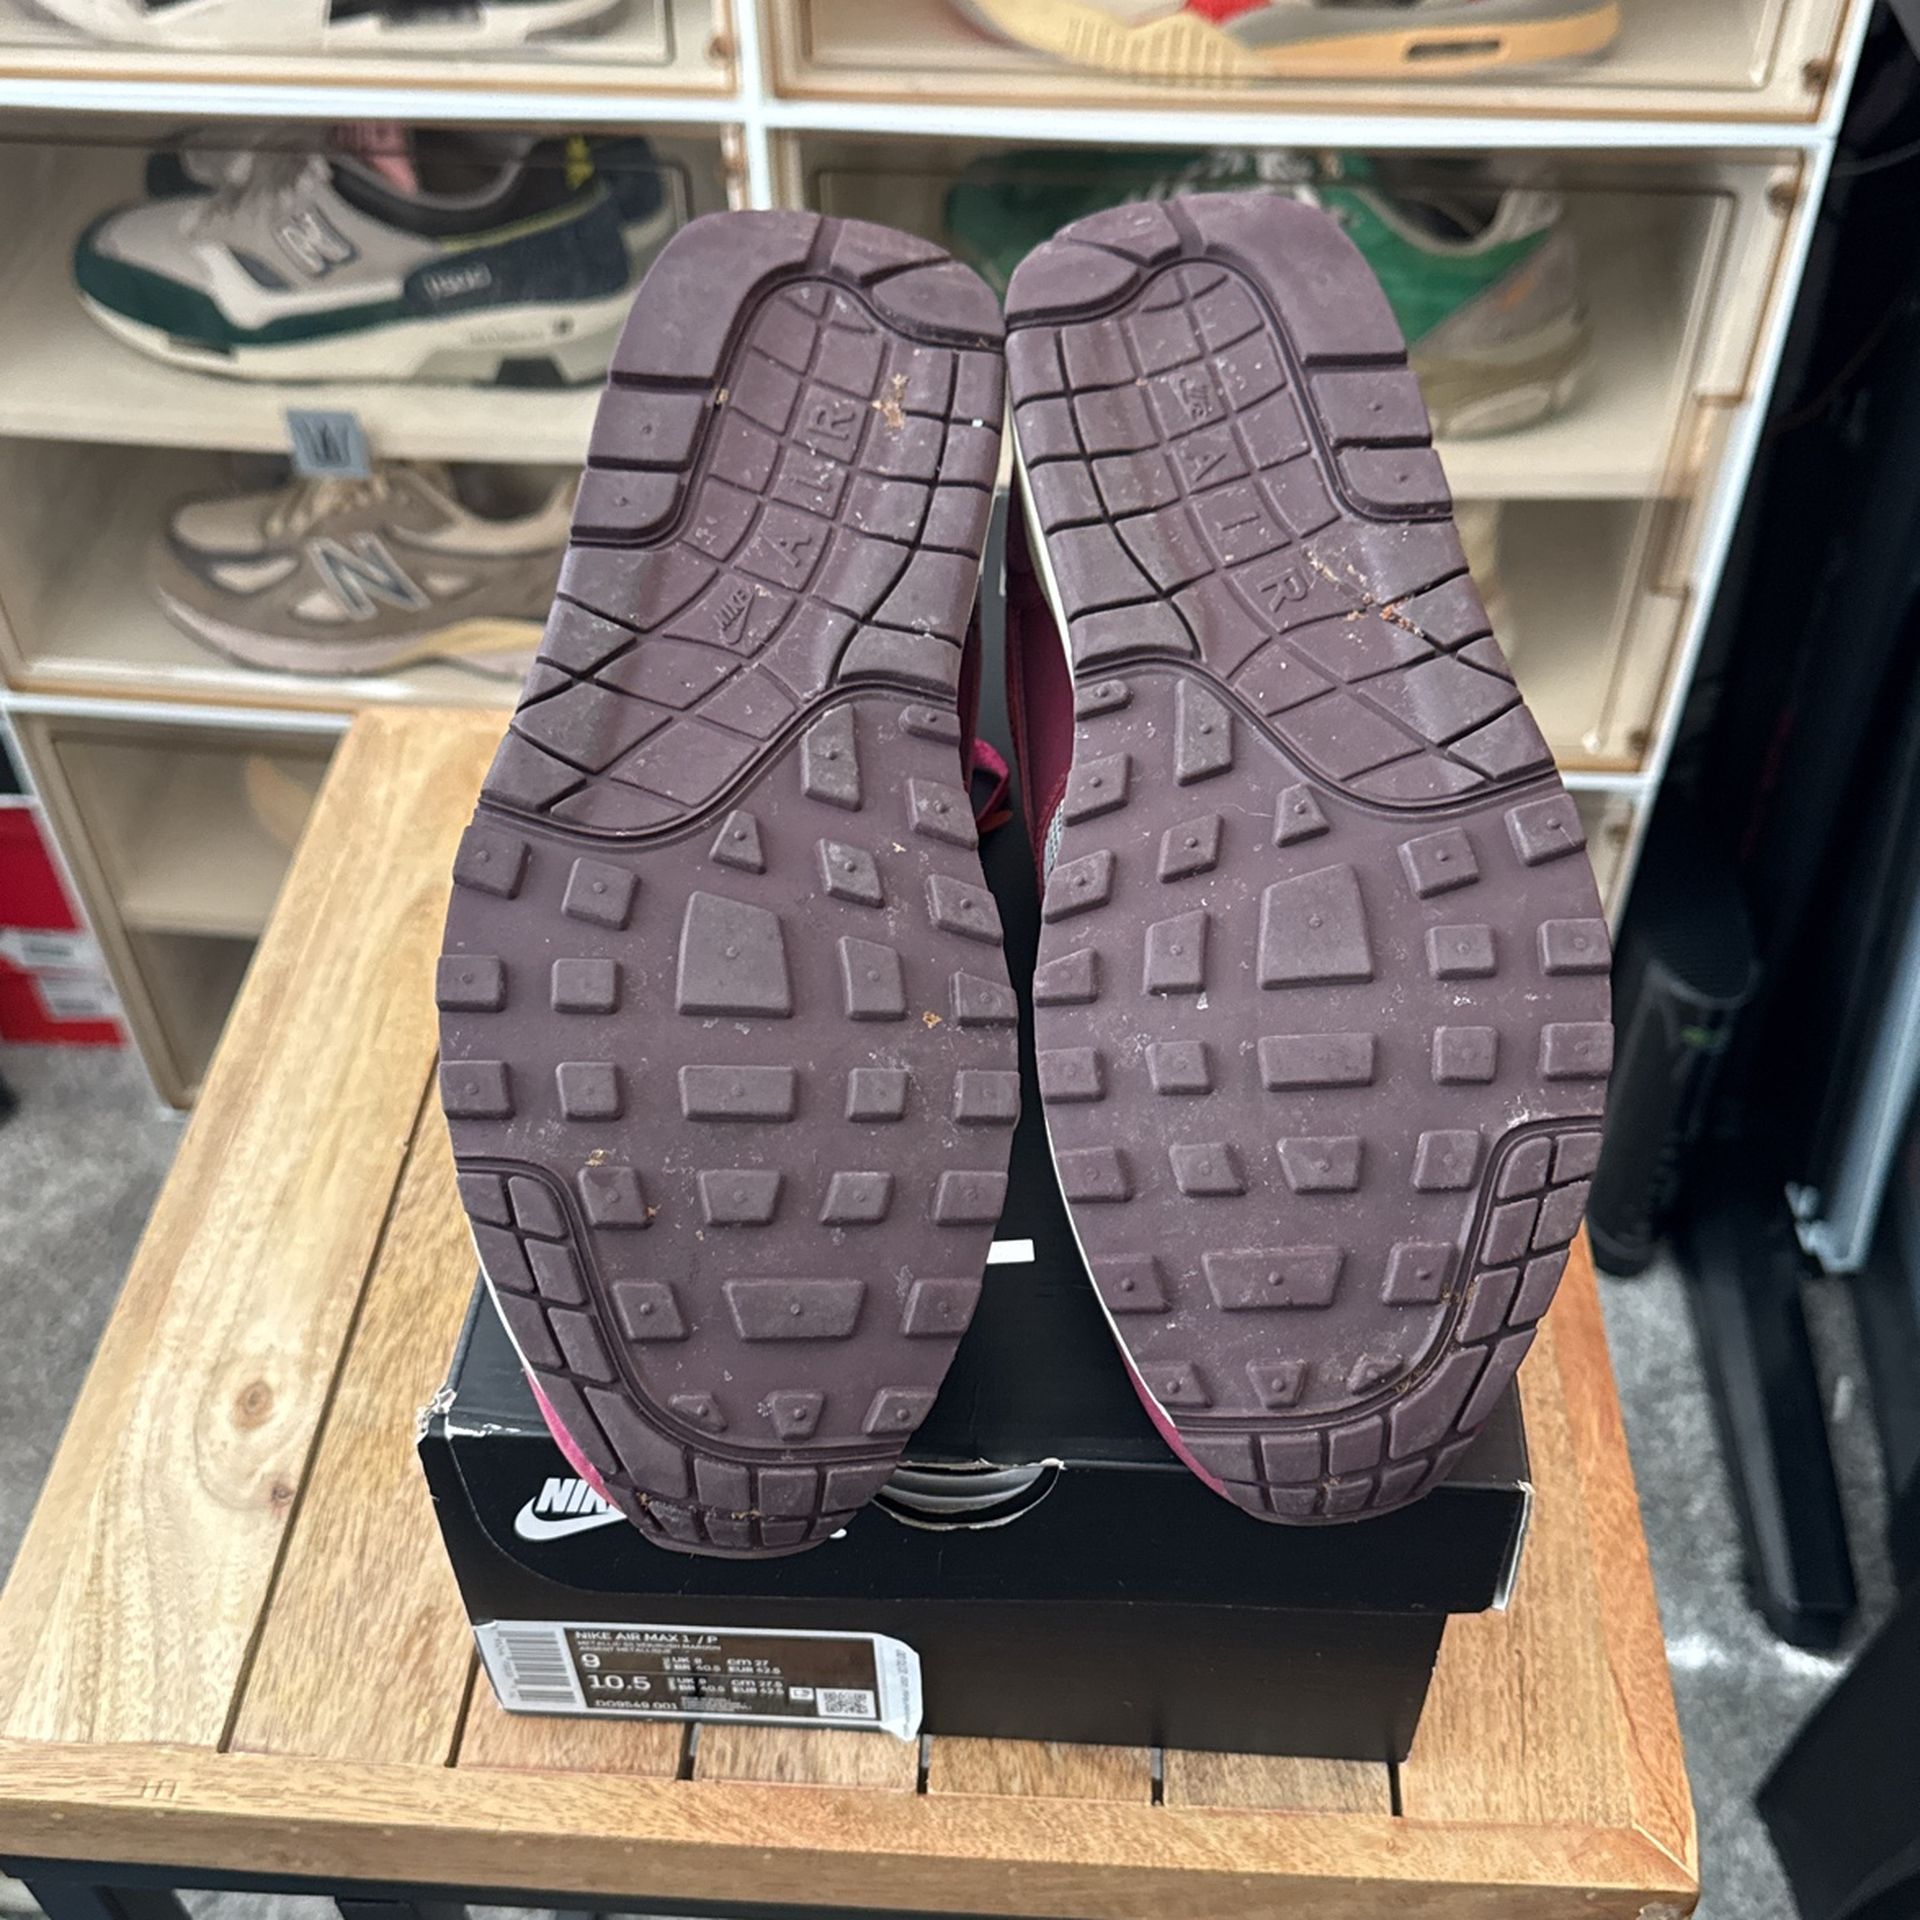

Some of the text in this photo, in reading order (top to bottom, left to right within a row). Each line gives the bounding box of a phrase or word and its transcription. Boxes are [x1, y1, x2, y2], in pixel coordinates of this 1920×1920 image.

[306, 531, 432, 622] N
[712, 588, 750, 633] NIKE
[535, 1477, 609, 1513] NIK
[575, 1630, 612, 1641] NIKE
[615, 1631, 641, 1642] AIR
[643, 1633, 679, 1643] MAX
[681, 1634, 691, 1644] 1
[706, 1635, 719, 1645] P
[581, 1652, 601, 1669] 9
[587, 1674, 652, 1691] 10.5
[652, 1701, 679, 1711] 001
